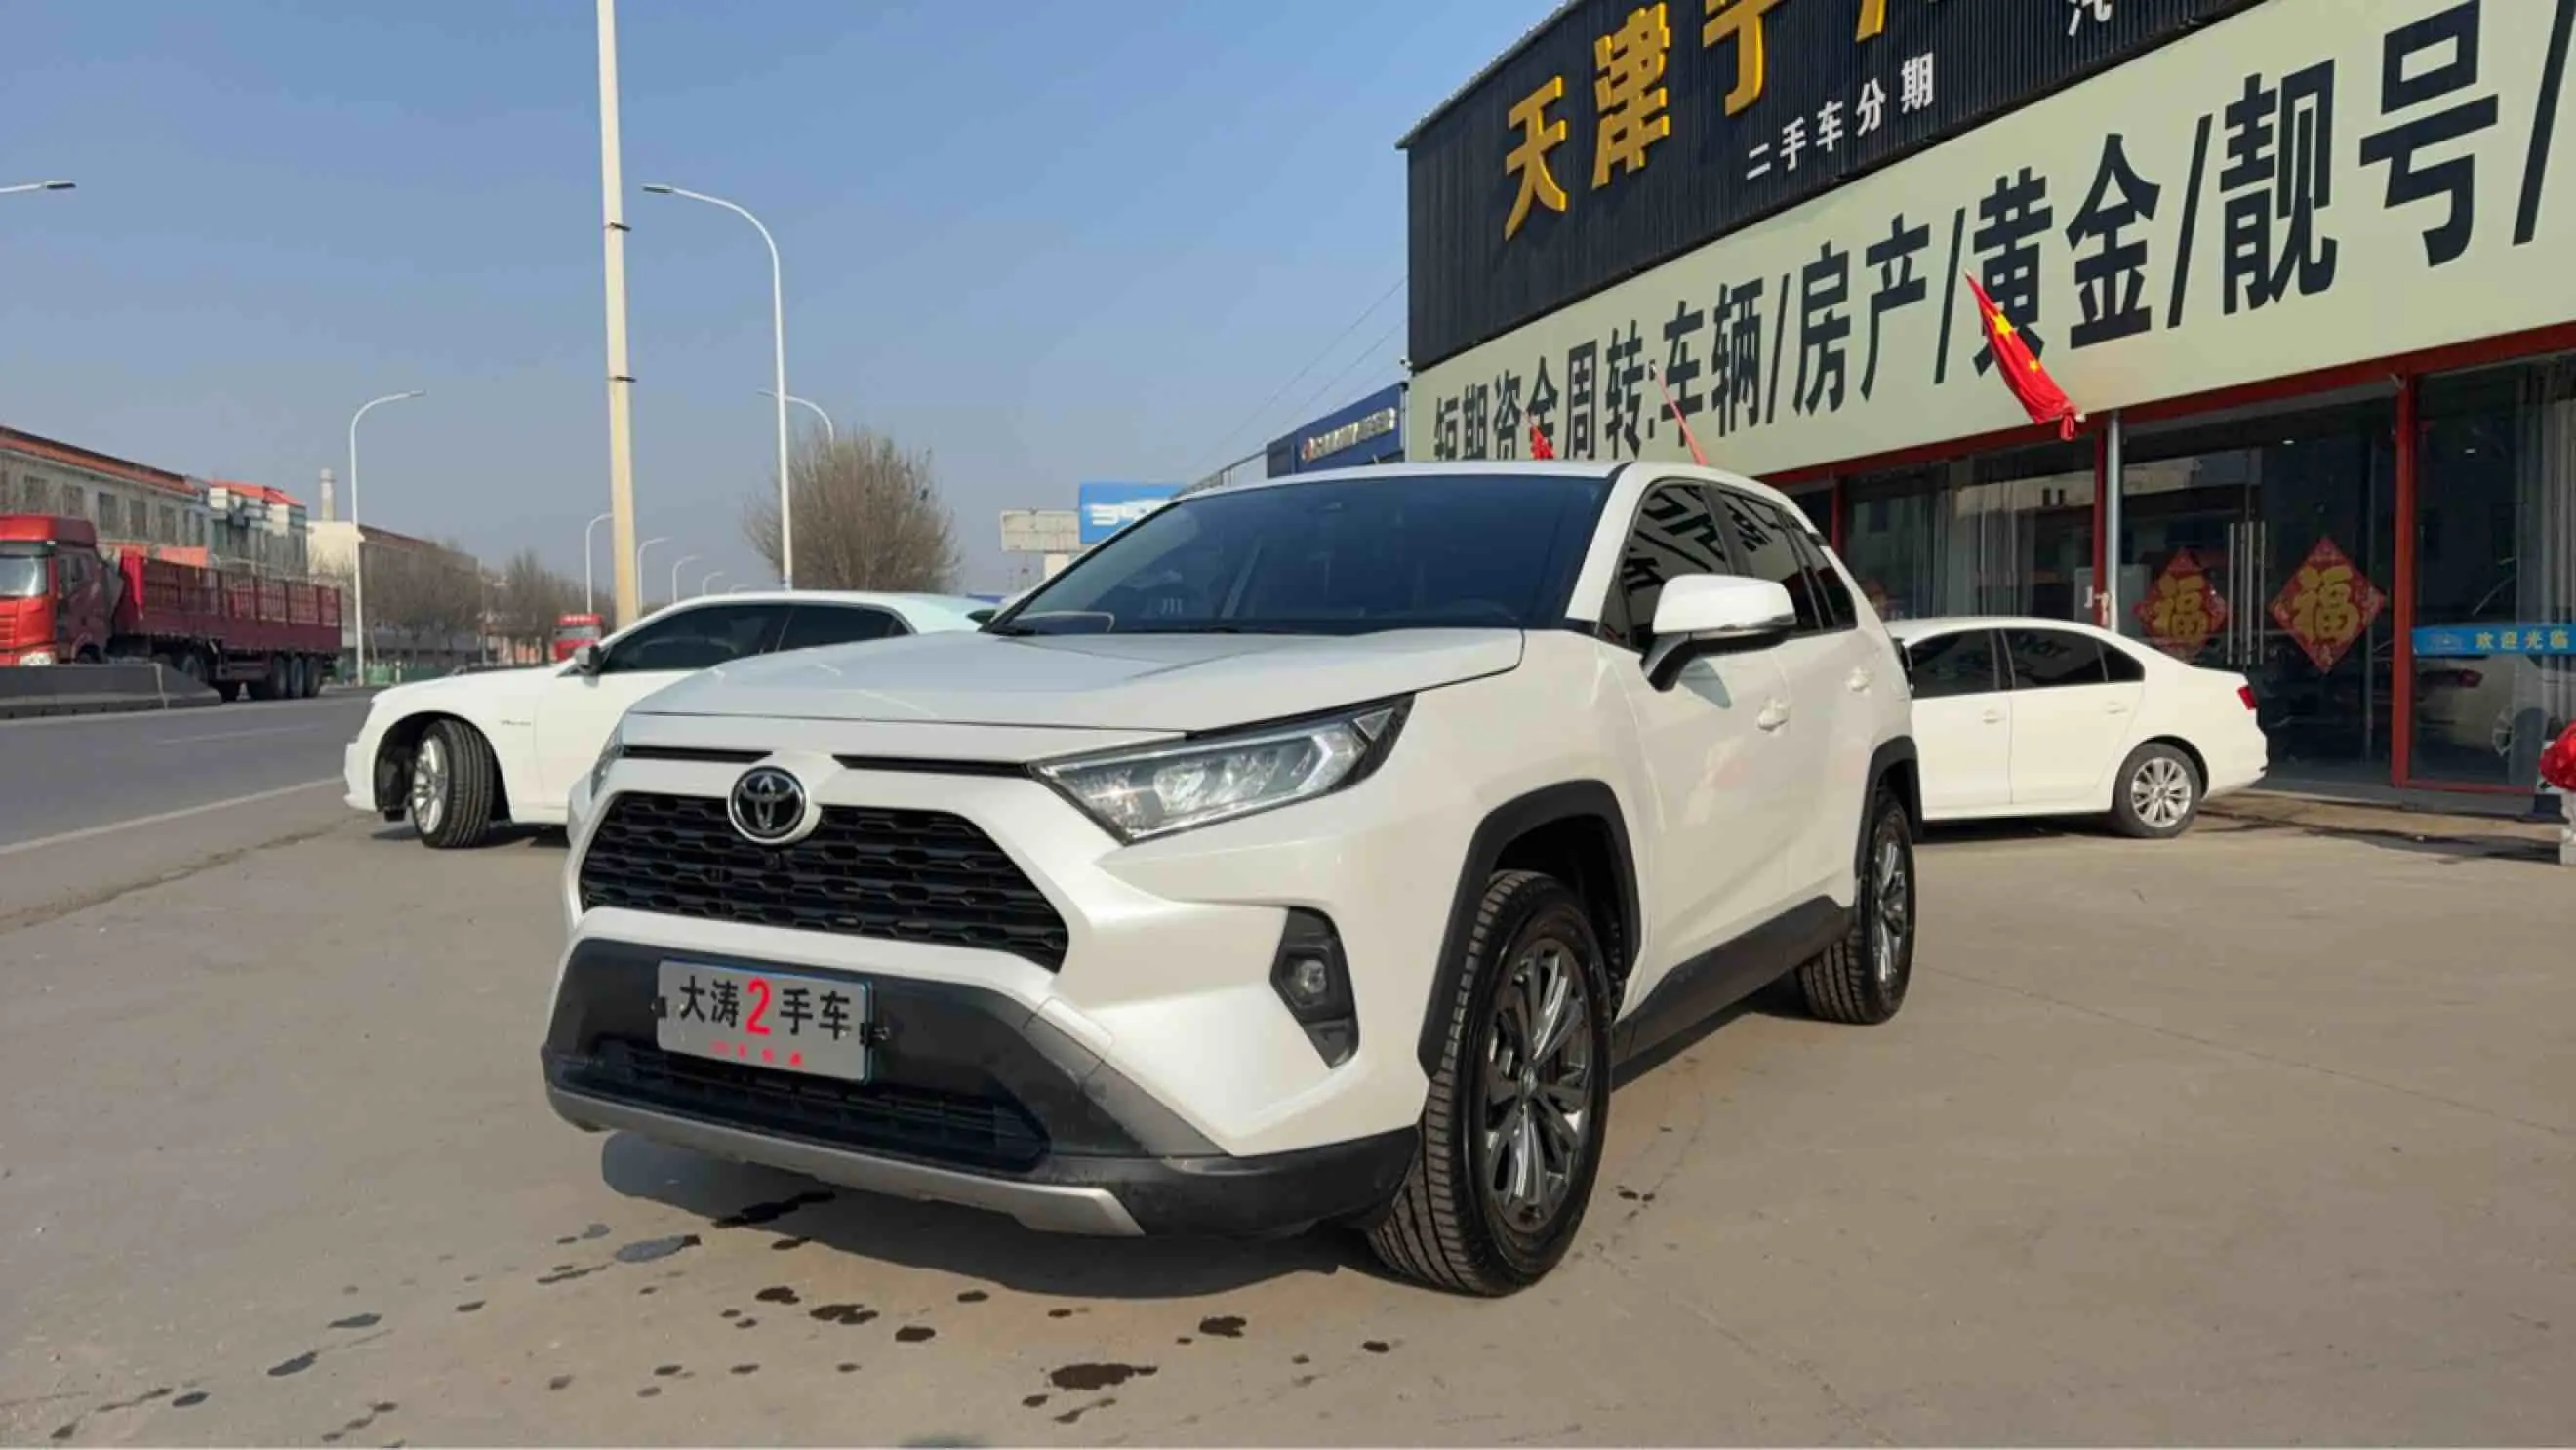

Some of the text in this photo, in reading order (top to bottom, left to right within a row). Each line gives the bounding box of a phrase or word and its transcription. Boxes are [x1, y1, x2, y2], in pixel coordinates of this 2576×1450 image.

[1505, 0, 1885, 241] 天津宁
[1746, 52, 1933, 180] 二手车分期
[2292, 563, 2362, 641] 福
[679, 975, 851, 1040] 大涛2手车
